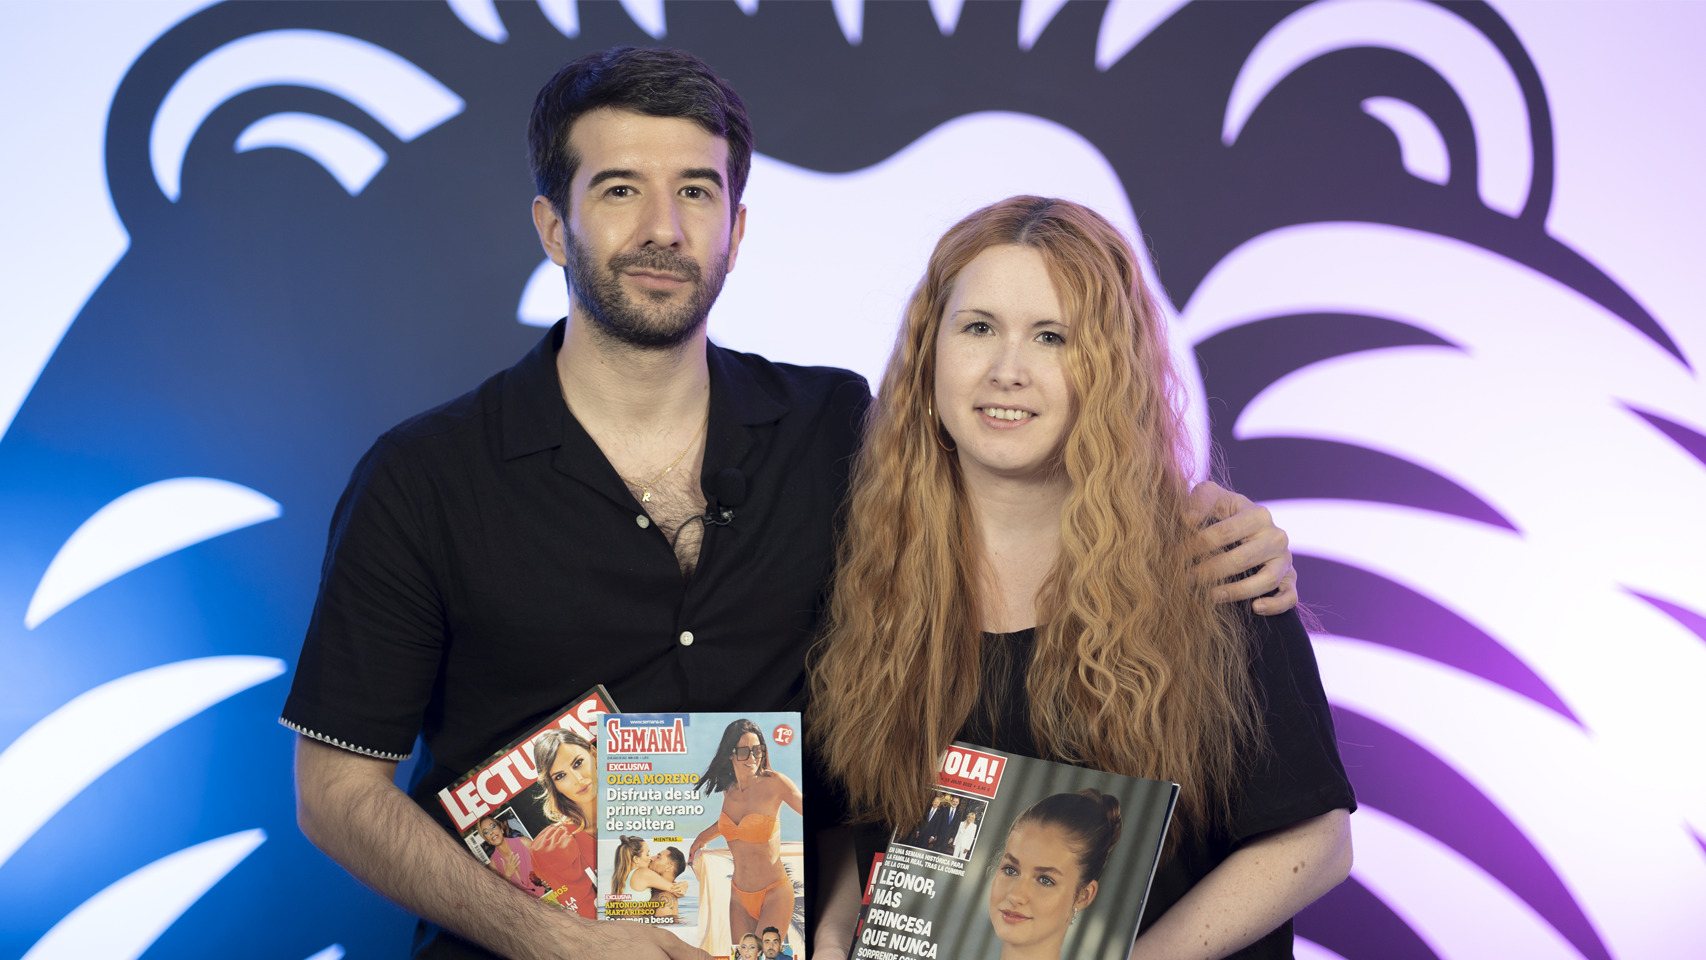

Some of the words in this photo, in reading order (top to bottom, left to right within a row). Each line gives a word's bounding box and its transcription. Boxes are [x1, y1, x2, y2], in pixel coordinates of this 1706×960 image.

[642, 492, 651, 502] R
[607, 719, 686, 753] SEMANA
[437, 699, 603, 831] LECTUAS
[609, 763, 650, 771] EXCLUSIVA
[607, 774, 642, 785] OLGA
[643, 773, 700, 784] MORENO
[606, 787, 662, 801] Disfruta
[664, 787, 681, 800] de
[684, 788, 700, 800] su
[606, 803, 653, 819] primer
[656, 806, 704, 815] verano
[605, 818, 626, 831] de
[628, 817, 674, 830] soltera
[892, 855, 910, 863] FAMILIA
[910, 858, 923, 868] REAL,
[924, 862, 937, 870] TRAS
[944, 867, 965, 877] CUMBRE
[905, 850, 924, 859] SEMANA
[924, 854, 950, 866] HISTÓRICA
[950, 861, 964, 869] PARA
[879, 868, 936, 899] LEONOR,
[873, 887, 902, 908] MÁS
[867, 908, 932, 937] PRINCESA
[862, 928, 889, 948] QUE
[889, 933, 938, 959] NUNCA
[857, 947, 898, 960] SORPRENDE
